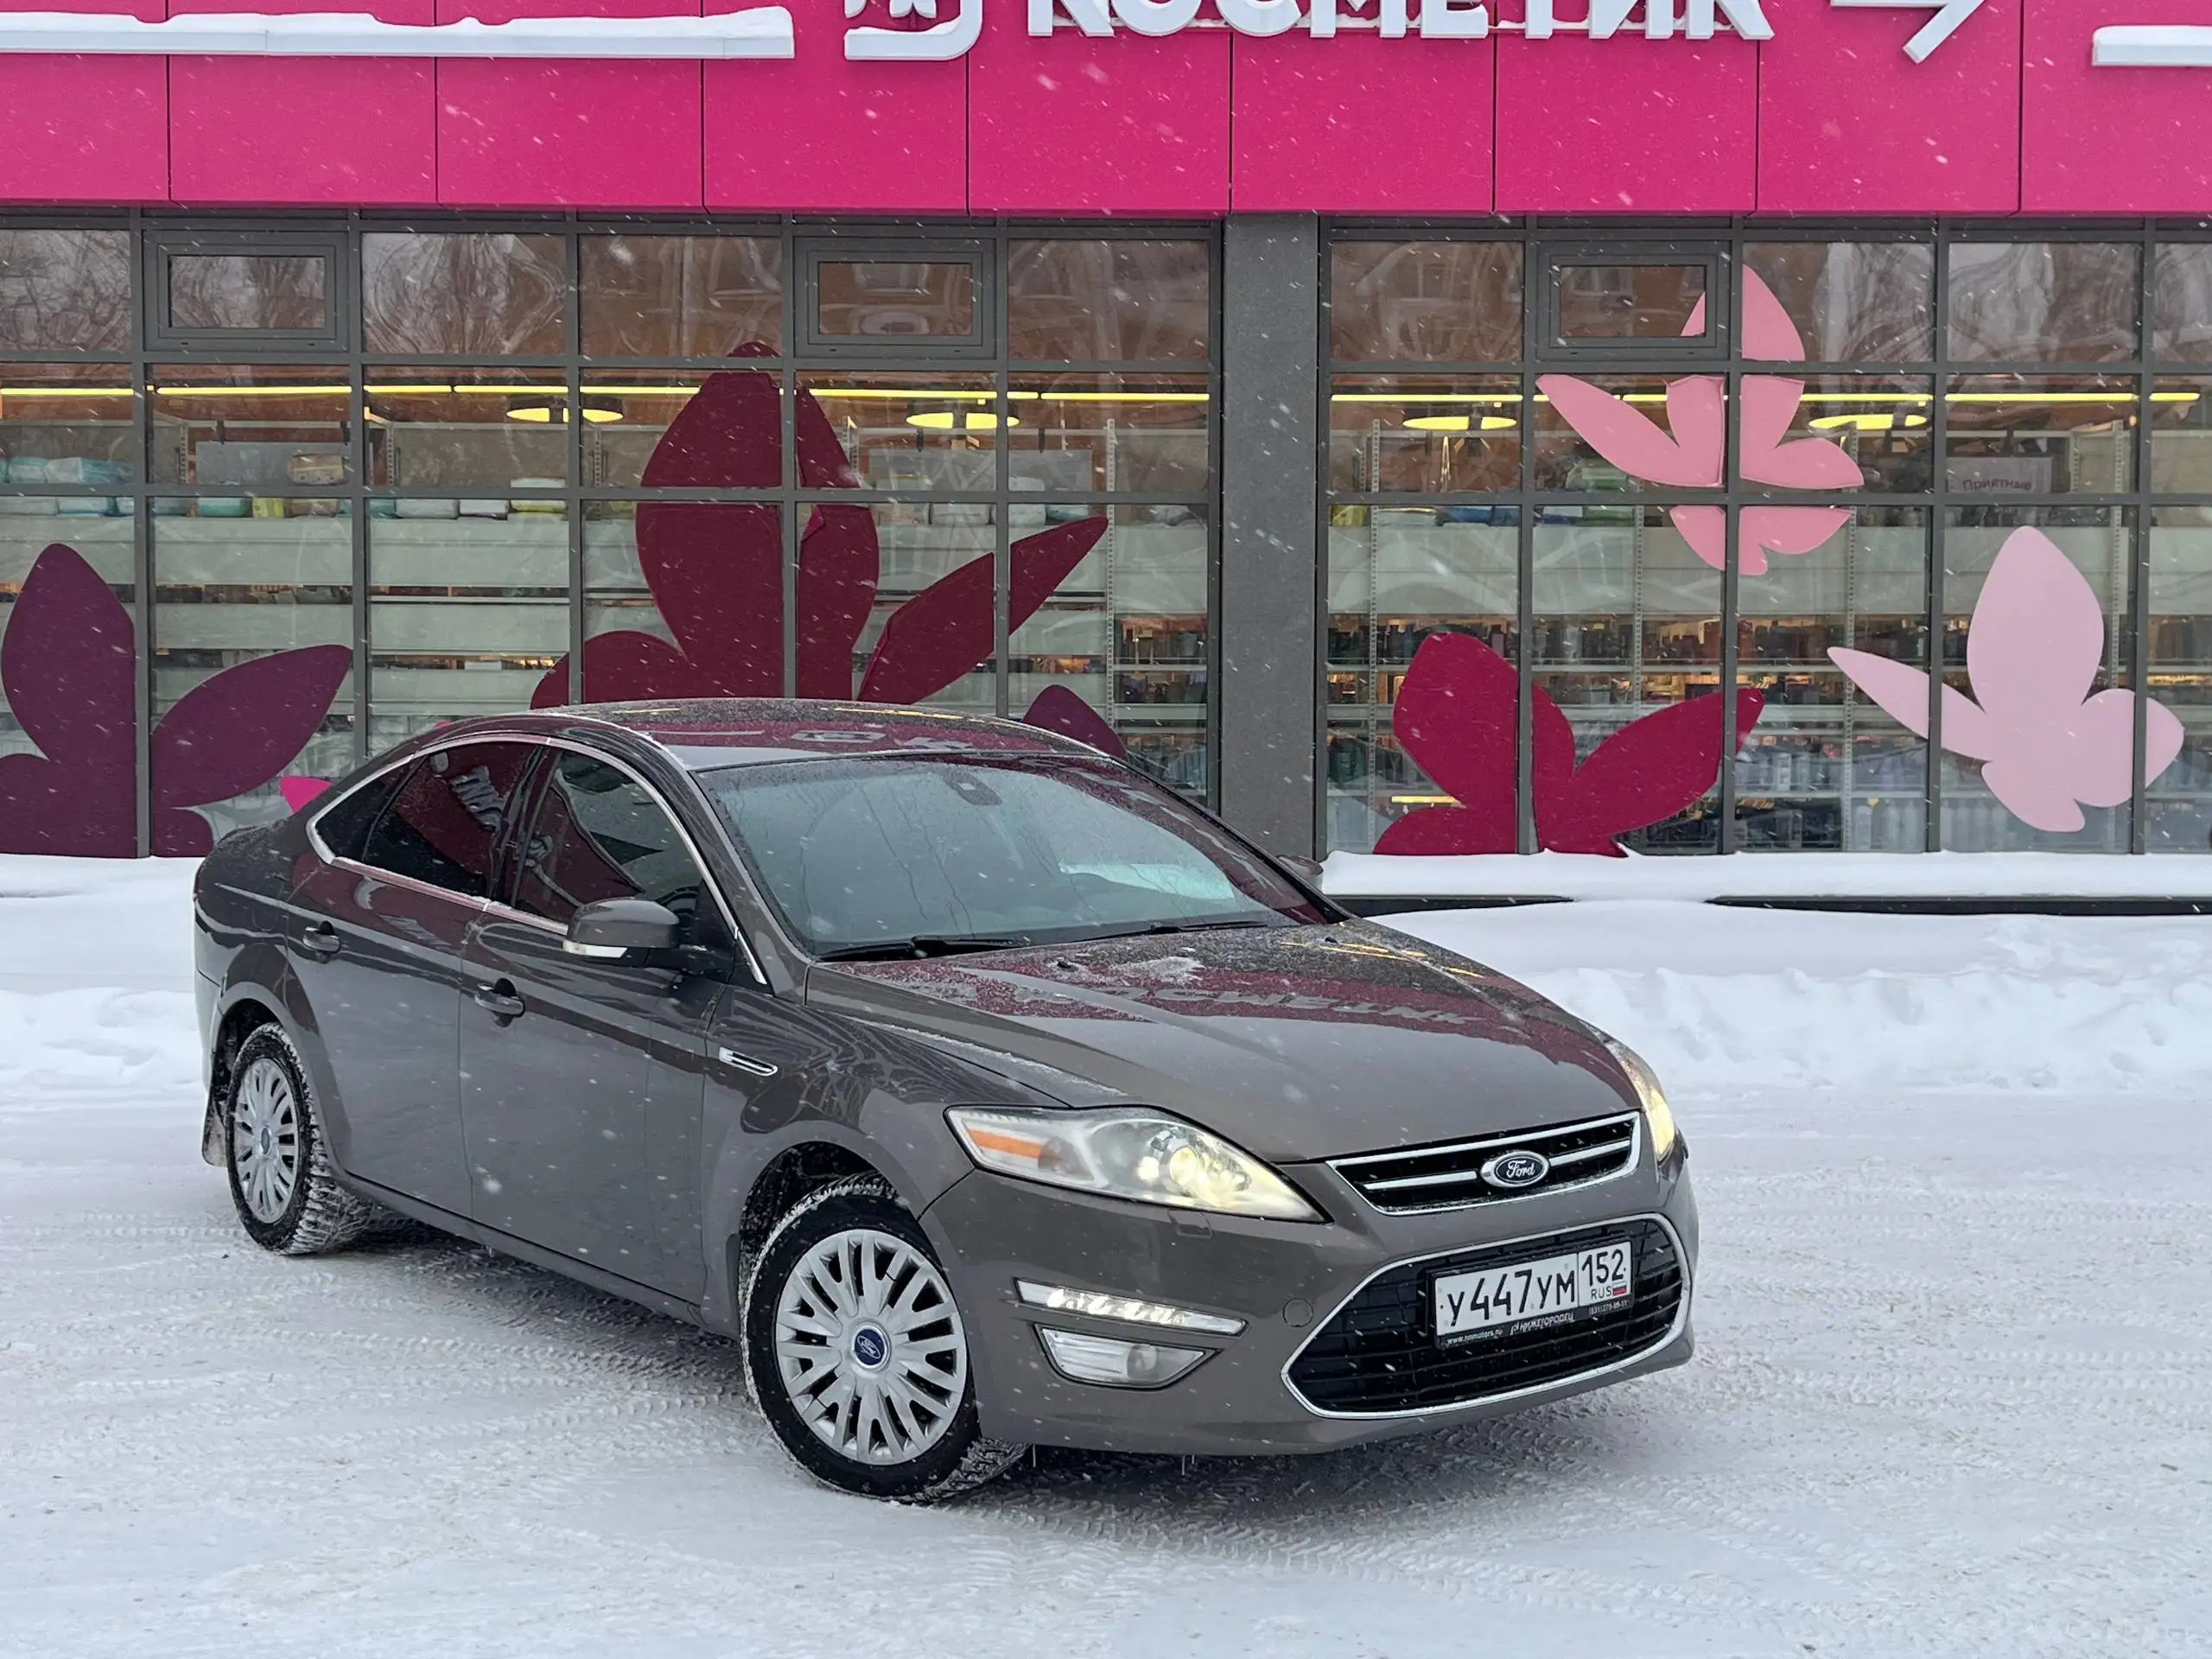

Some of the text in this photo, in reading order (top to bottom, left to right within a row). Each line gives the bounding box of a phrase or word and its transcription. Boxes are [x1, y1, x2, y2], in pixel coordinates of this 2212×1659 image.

[1506, 1160, 1535, 1179] Ford
[1447, 1248, 1624, 1326] У447УМ 152
[1590, 1285, 1612, 1300] RUS
